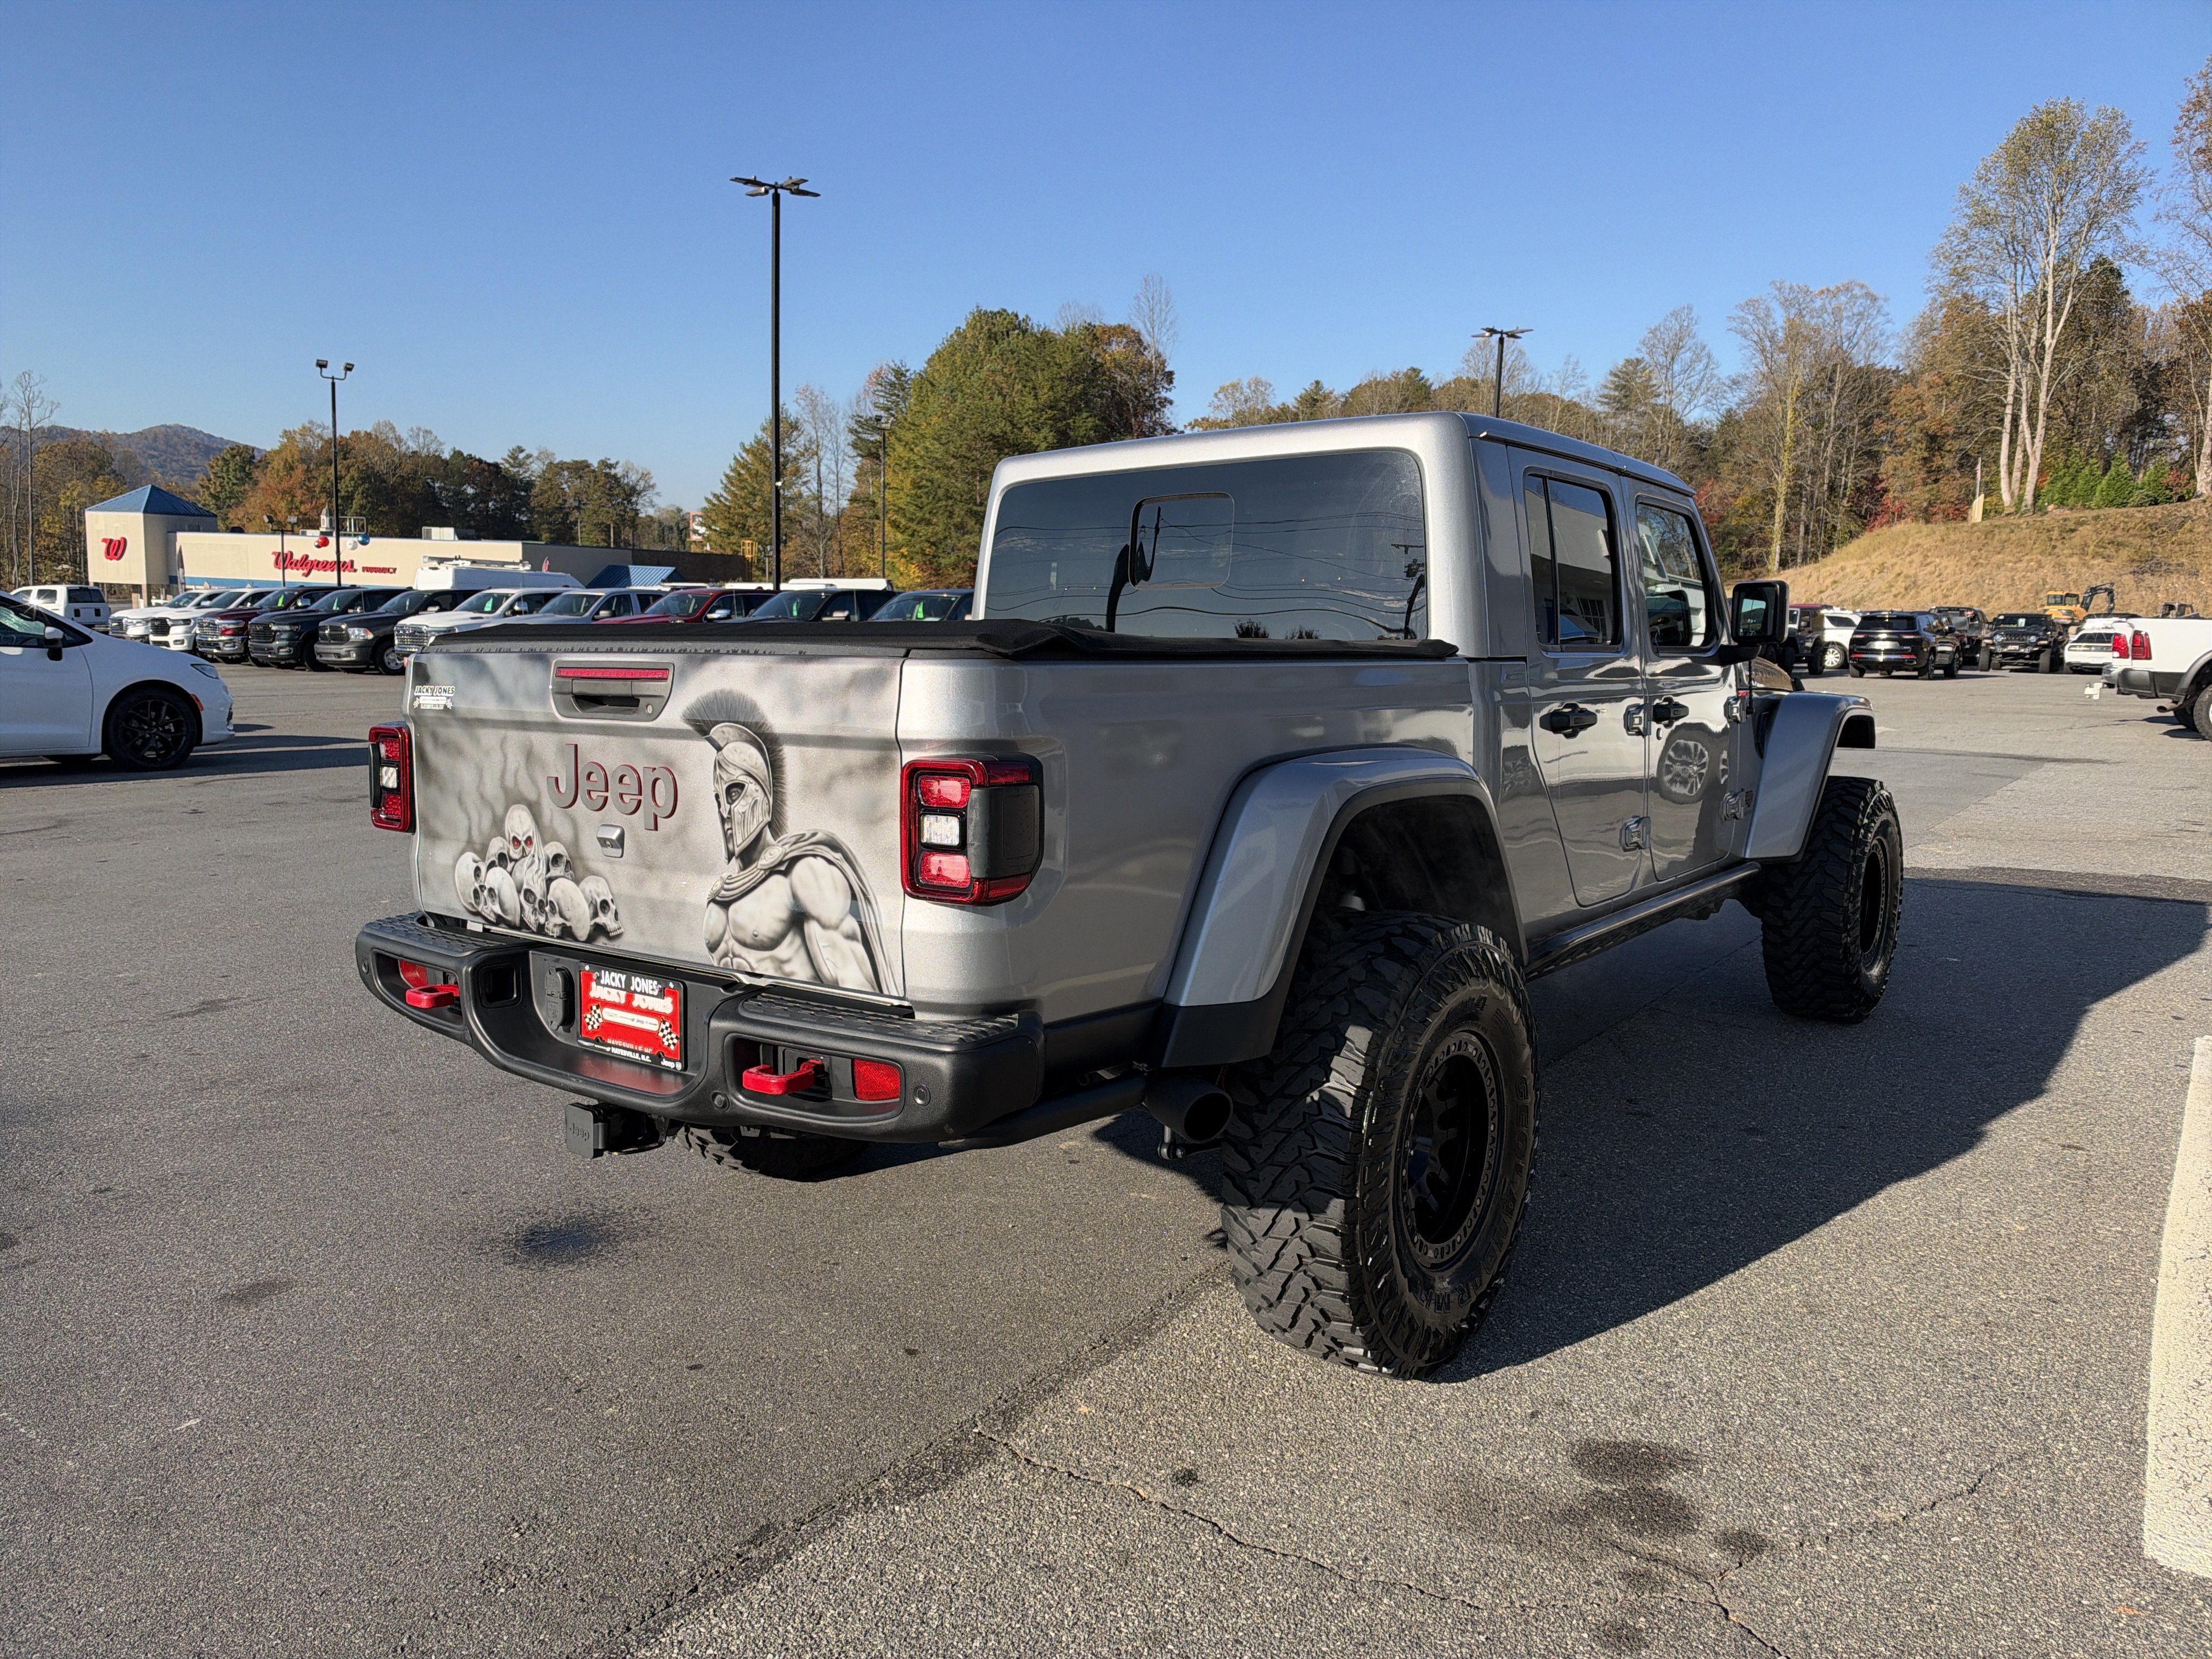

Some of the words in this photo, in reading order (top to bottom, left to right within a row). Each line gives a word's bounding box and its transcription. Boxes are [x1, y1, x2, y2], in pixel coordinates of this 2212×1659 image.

[101, 537, 127, 561] W
[272, 551, 358, 577] Walgreens
[414, 685, 433, 696] JACKY
[433, 685, 455, 696] JONES
[546, 743, 678, 832] Jeep
[600, 970, 627, 989] JACKY
[630, 976, 658, 996] JONES
[612, 1047, 641, 1060] HAYESVILLE,
[661, 1058, 675, 1069] Jeep
[569, 1123, 590, 1142] Jeep
